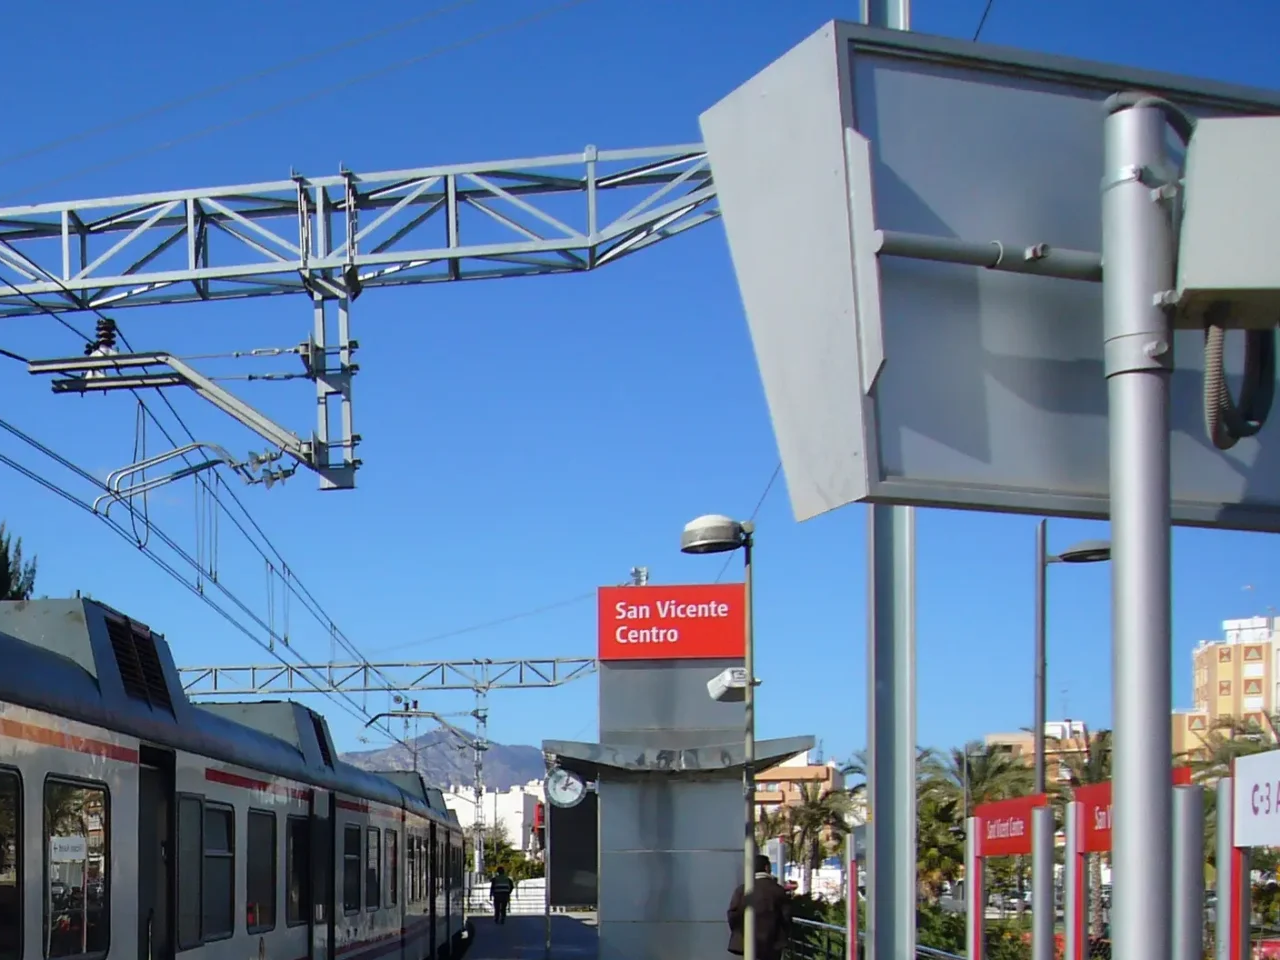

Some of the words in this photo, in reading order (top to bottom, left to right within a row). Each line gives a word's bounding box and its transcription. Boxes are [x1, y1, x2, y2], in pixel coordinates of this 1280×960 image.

[615, 602, 650, 619] San
[656, 600, 729, 618] Vicente
[615, 626, 678, 643] Centro
[1251, 782, 1271, 816] C-3
